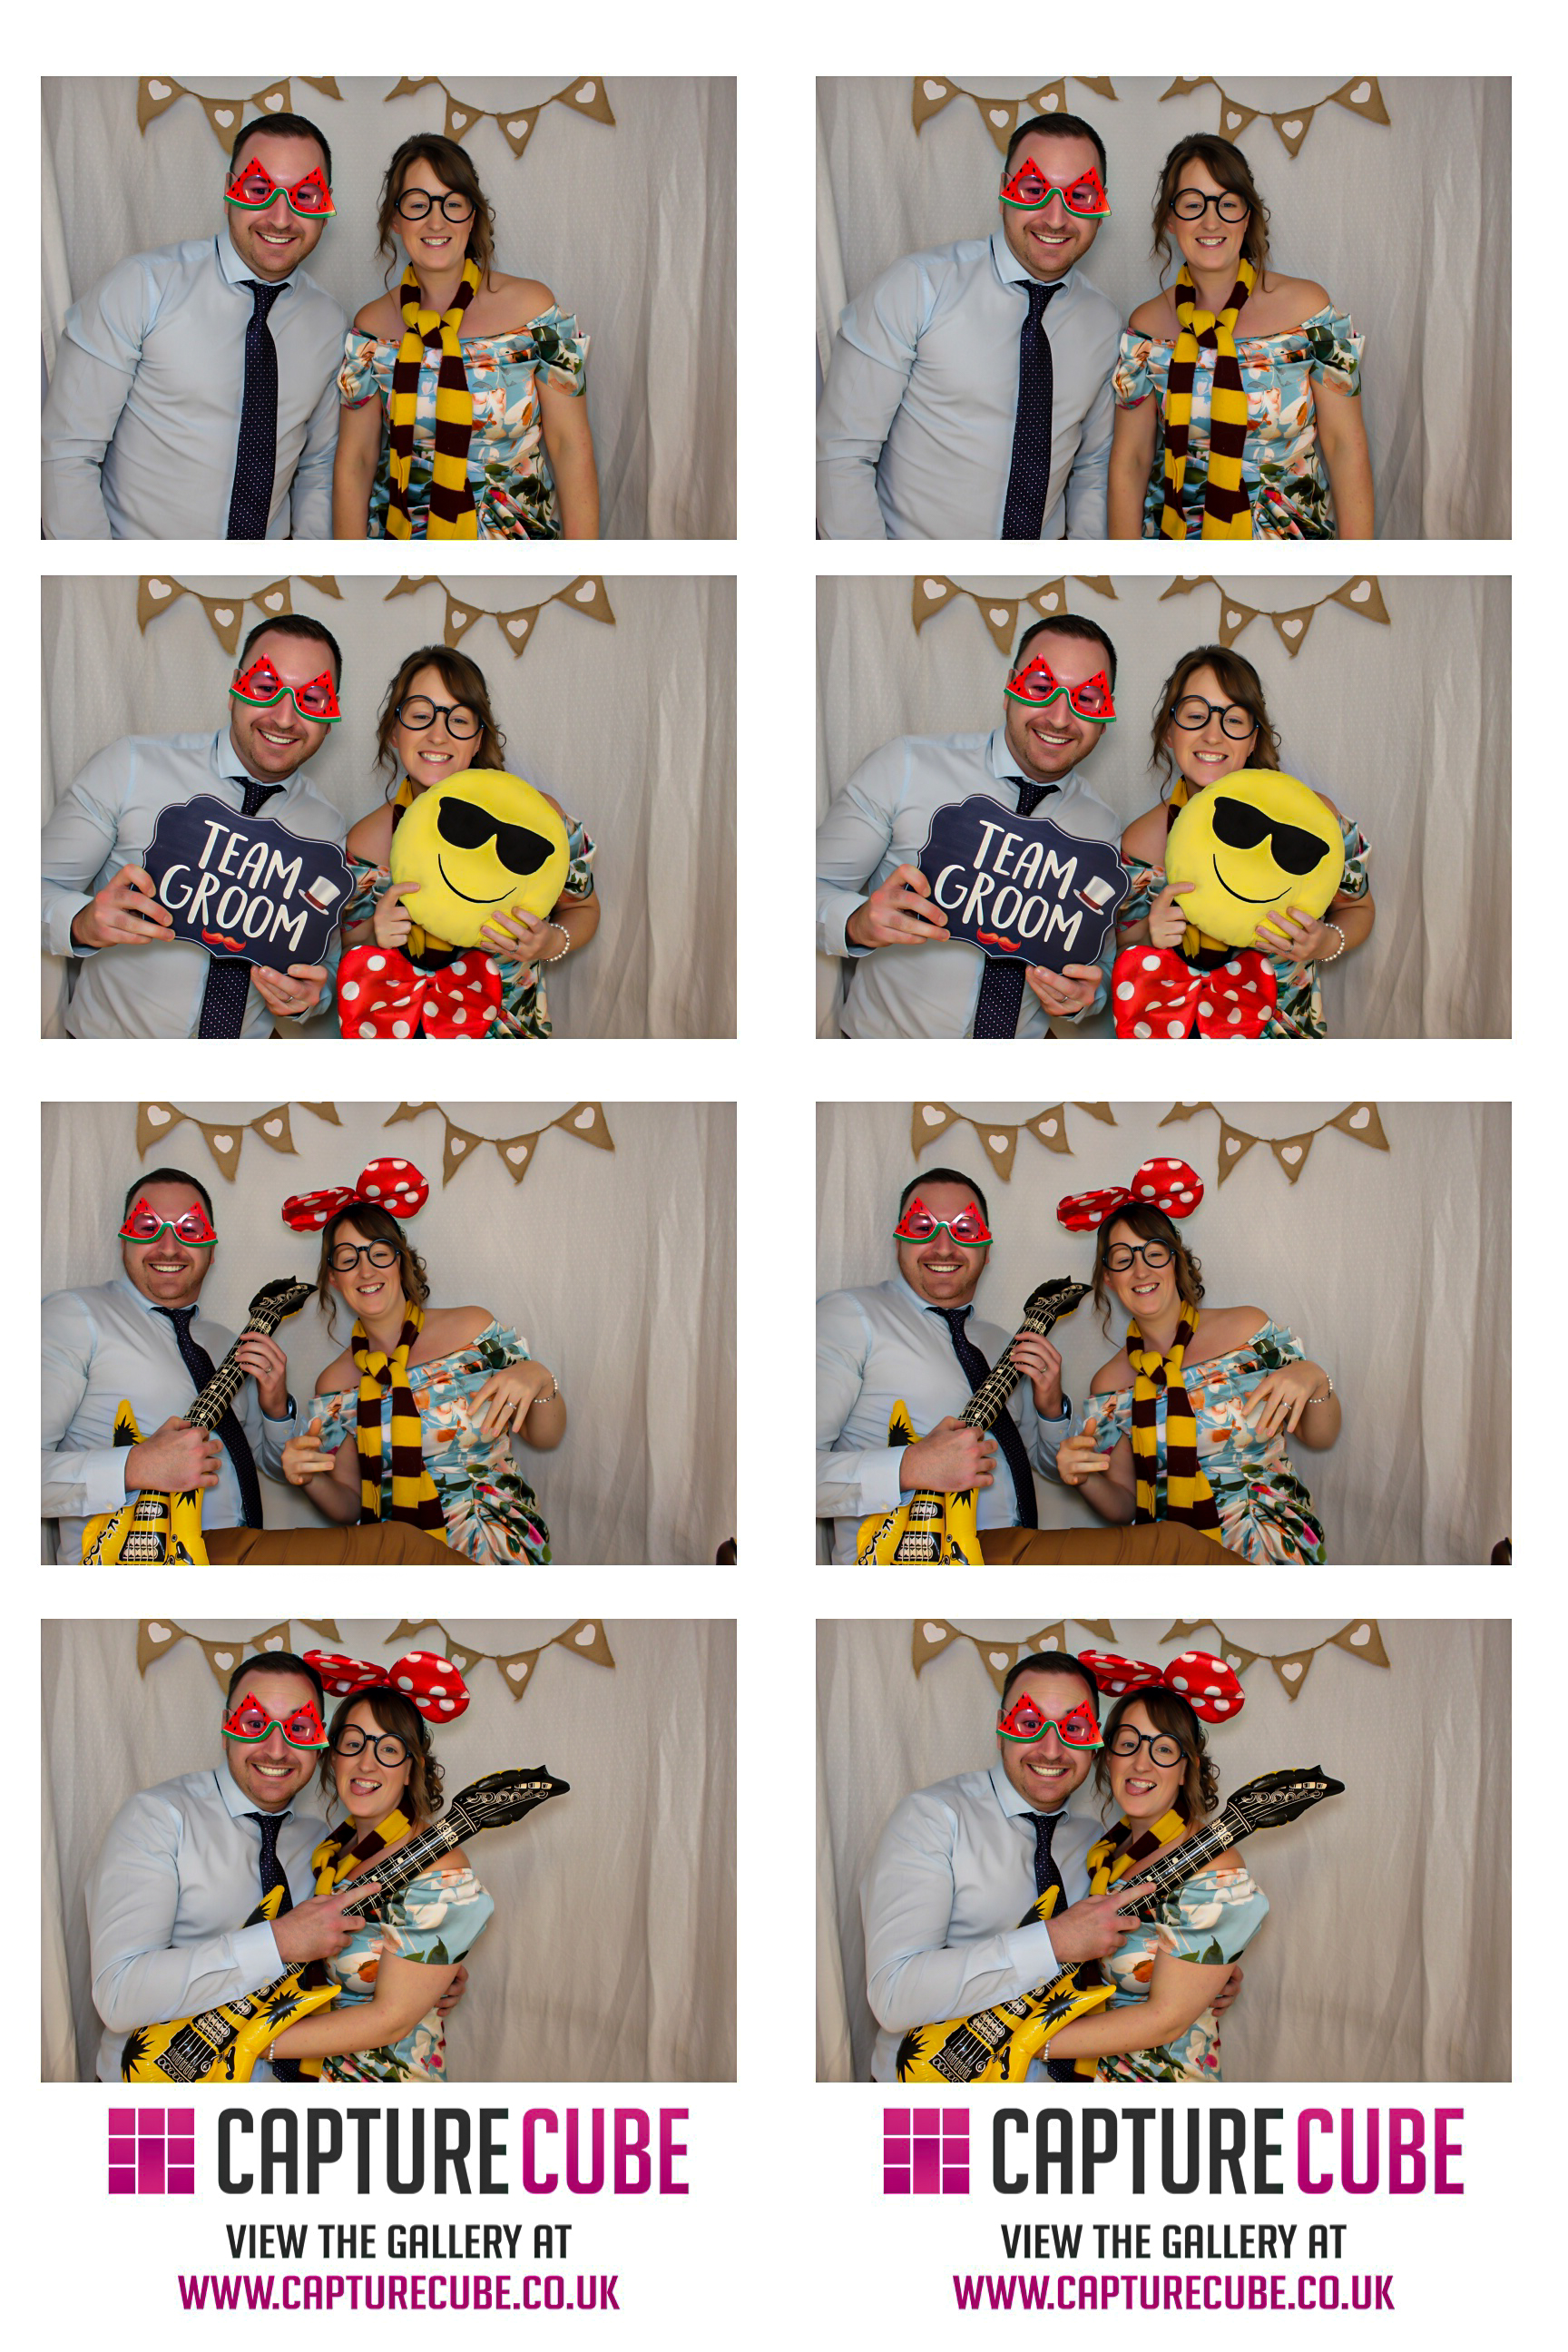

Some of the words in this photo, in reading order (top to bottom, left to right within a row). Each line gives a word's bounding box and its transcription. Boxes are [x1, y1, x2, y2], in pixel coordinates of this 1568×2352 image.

[198, 819, 303, 900] TEAM
[973, 819, 1078, 900] TEAM
[159, 864, 309, 952] GROOM
[934, 864, 1083, 952] GROOM
